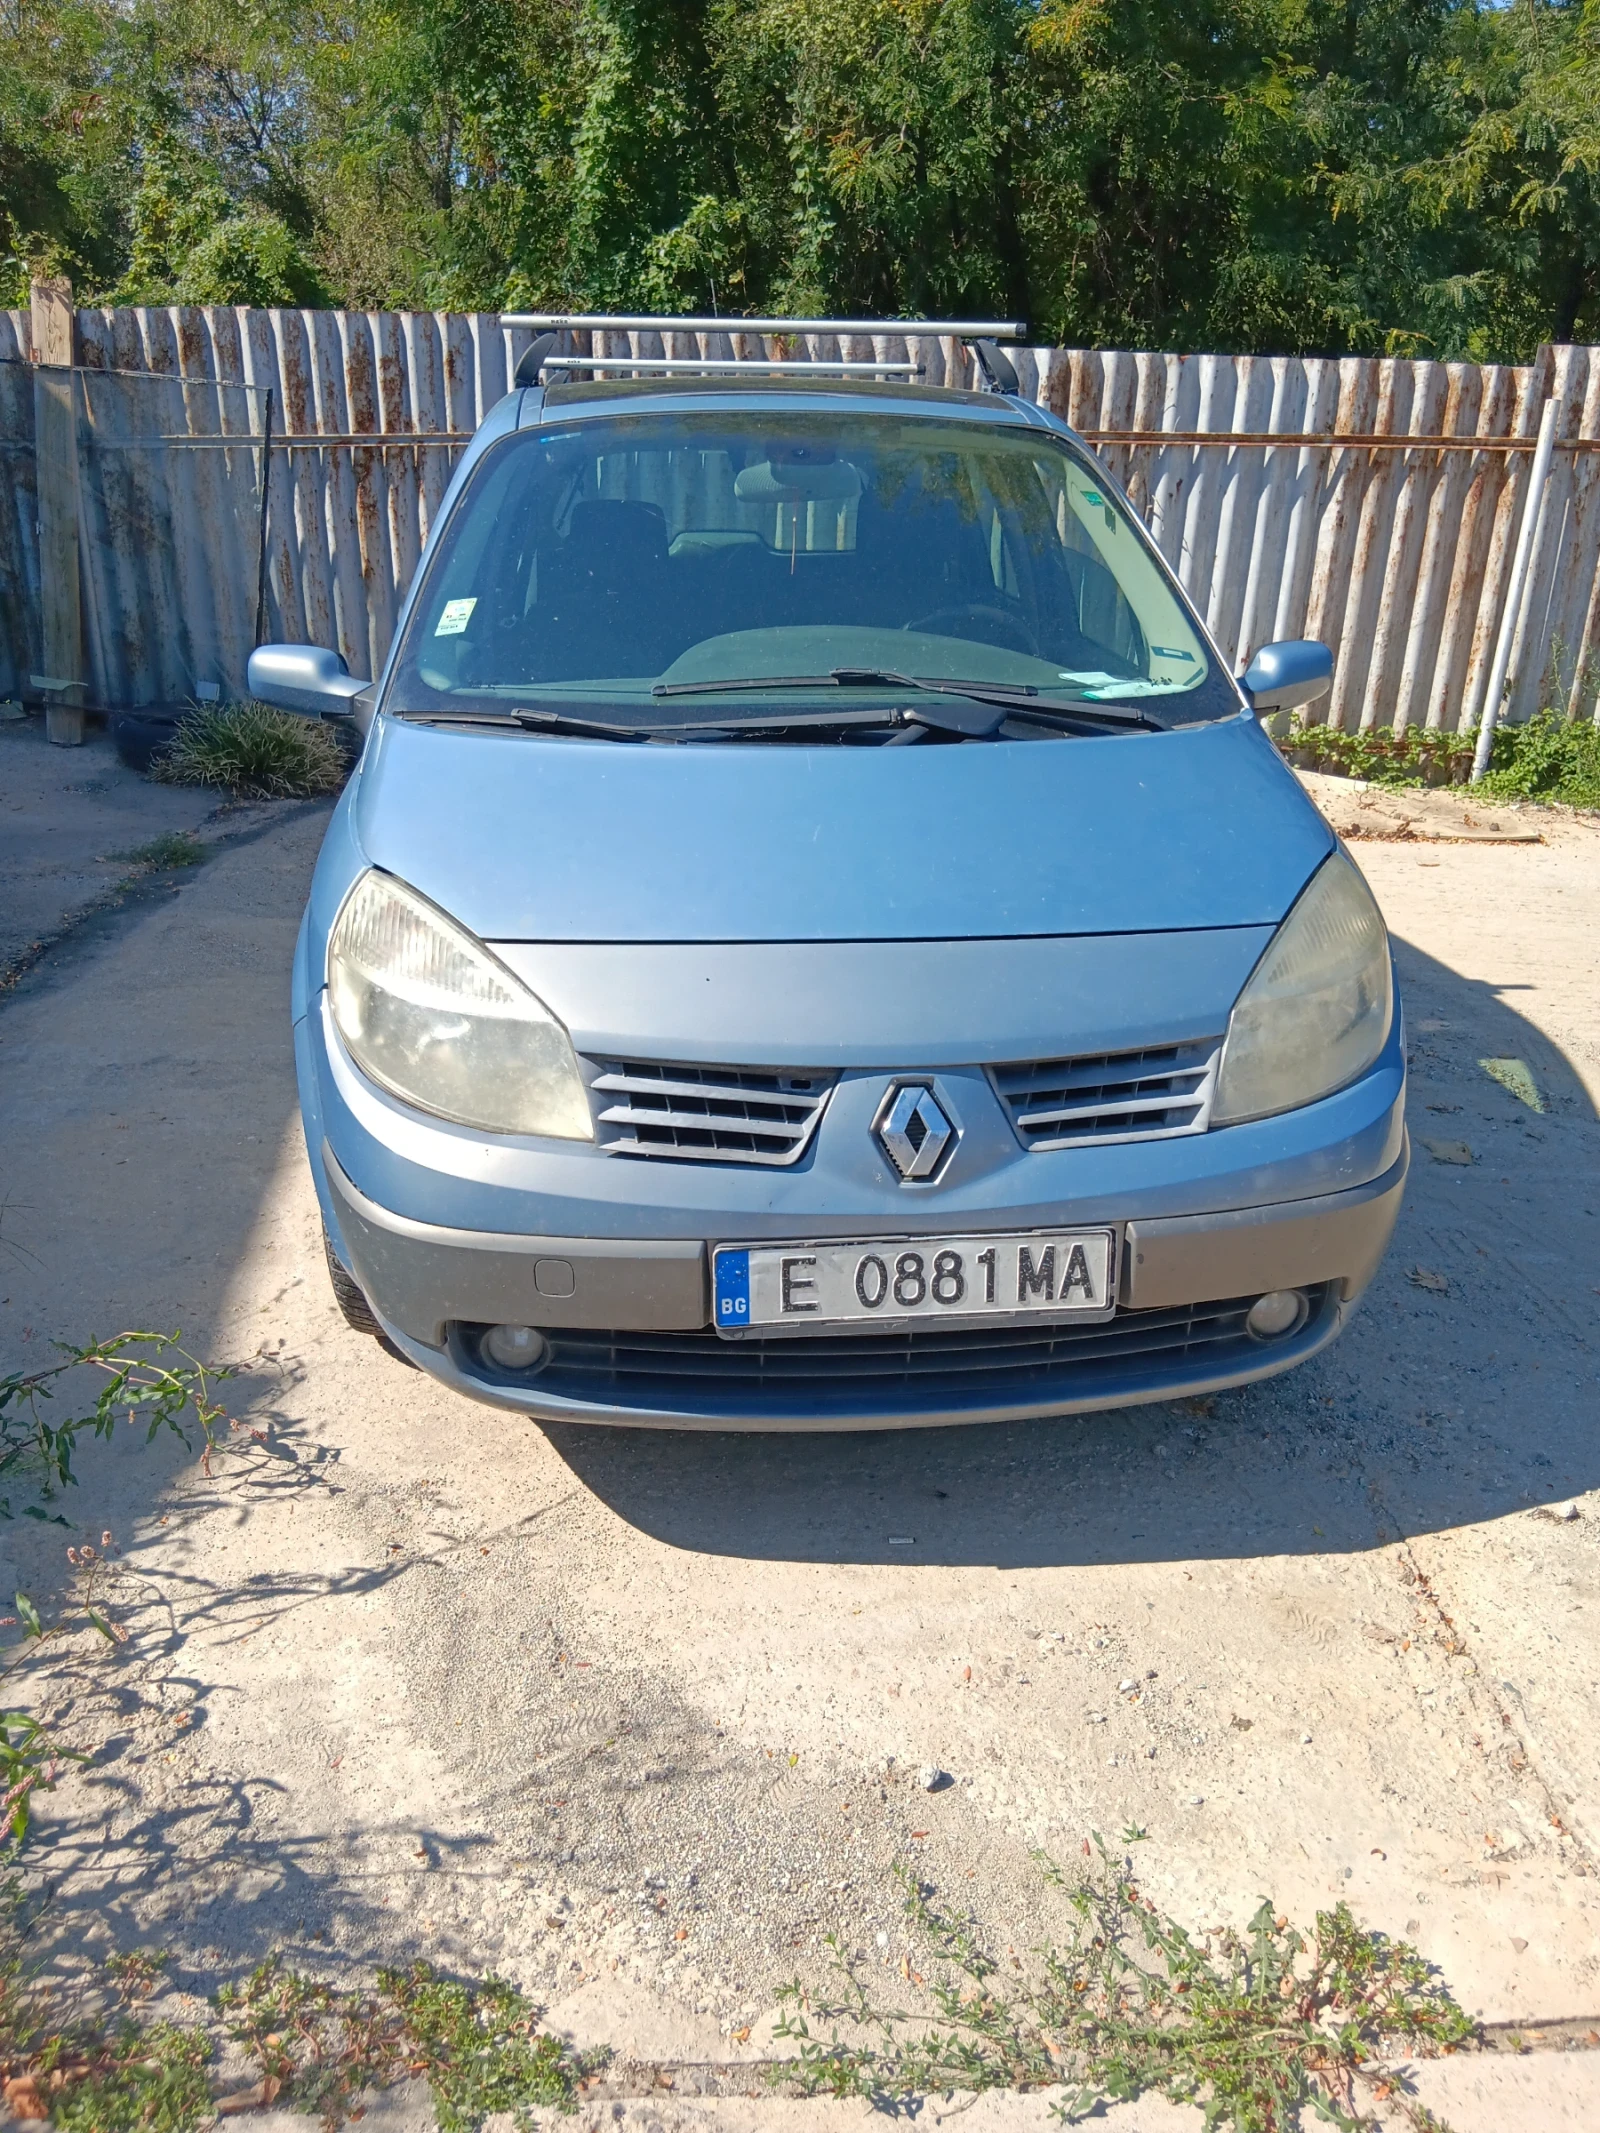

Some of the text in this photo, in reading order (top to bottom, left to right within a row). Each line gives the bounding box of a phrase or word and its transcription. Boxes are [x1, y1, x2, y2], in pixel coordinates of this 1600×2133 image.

[780, 1243, 1094, 1313] E 0881 MA
[721, 1297, 747, 1315] BG
